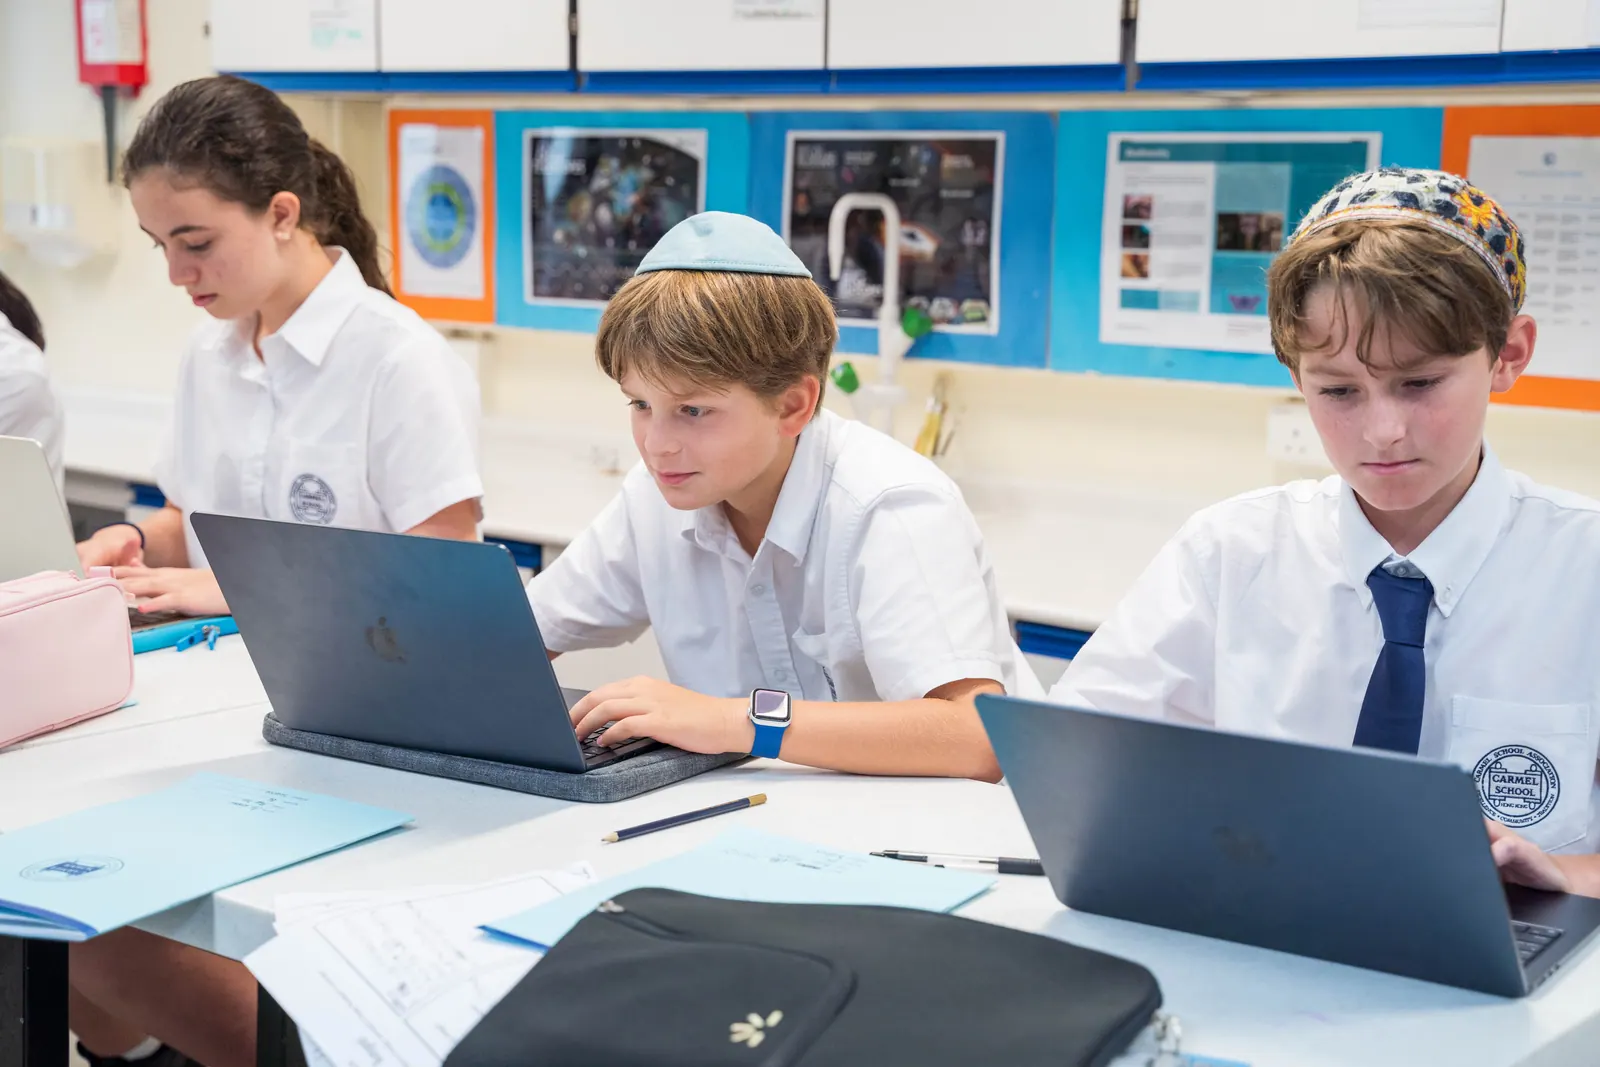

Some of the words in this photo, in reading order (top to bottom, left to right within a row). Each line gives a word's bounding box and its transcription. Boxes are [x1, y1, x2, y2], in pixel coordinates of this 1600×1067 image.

[1475, 758, 1492, 782] CARMEL
[1494, 748, 1524, 757] SCHOOL
[1527, 751, 1557, 789] ASSOCIATION
[1492, 775, 1539, 785] CARMEL
[1495, 786, 1535, 796] SCHOOL
